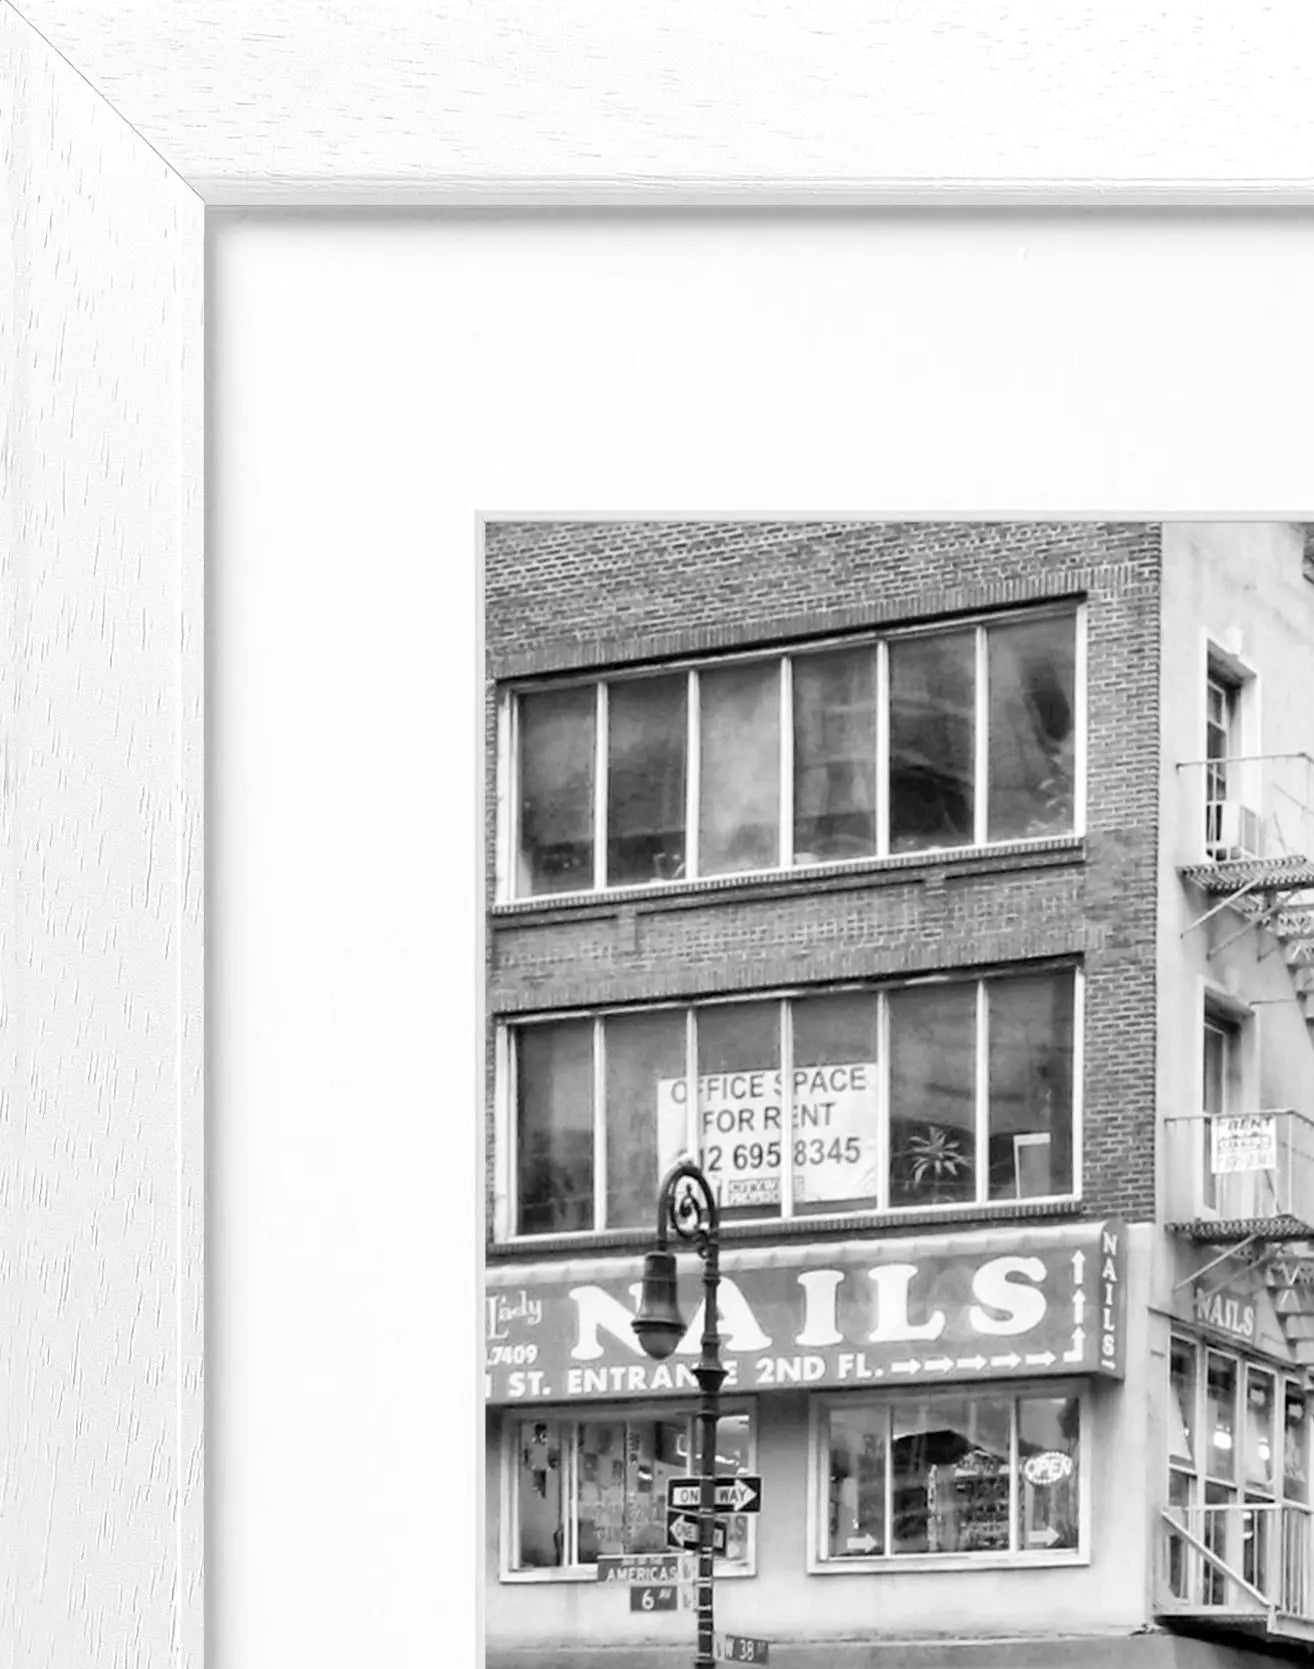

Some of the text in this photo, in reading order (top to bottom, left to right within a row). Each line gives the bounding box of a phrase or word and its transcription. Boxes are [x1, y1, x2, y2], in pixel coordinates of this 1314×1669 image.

[703, 1108, 755, 1135] FOR
[734, 1142, 780, 1170] 695
[794, 1137, 860, 1165] 8345
[568, 1256, 1048, 1360] NAILS
[1102, 1232, 1118, 1357] NAILS
[1197, 1287, 1254, 1336] NAILS
[508, 1371, 551, 1395] ST.
[567, 1361, 738, 1394] ENTRANE
[755, 1356, 825, 1383] 2ND
[838, 1353, 884, 1379] FL.
[1026, 1456, 1072, 1481] OPEN
[680, 1488, 747, 1503] ON WAY
[606, 1565, 678, 1583] AMERICAS
[641, 1589, 655, 1610] 6
[739, 1639, 754, 1661] 38
